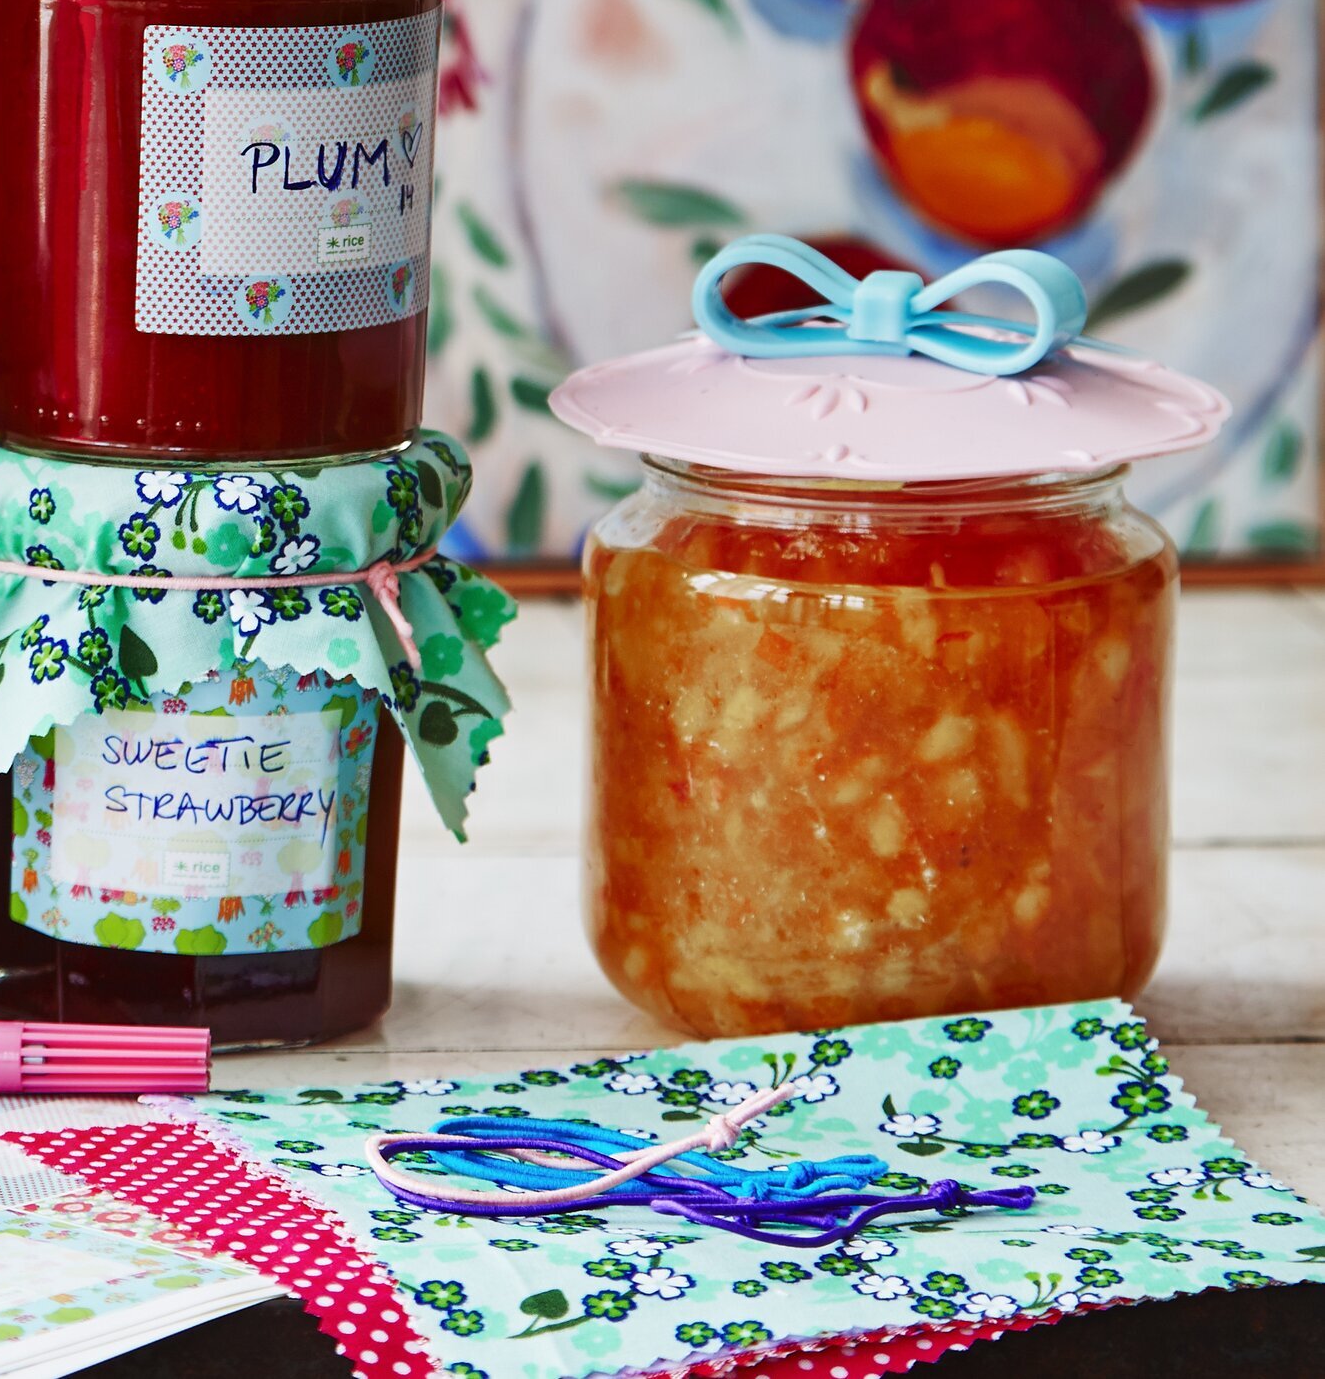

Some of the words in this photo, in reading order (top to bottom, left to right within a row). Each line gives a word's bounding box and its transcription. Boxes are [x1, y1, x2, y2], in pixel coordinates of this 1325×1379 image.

[241, 139, 390, 193] PLUM
[342, 234, 365, 248] rice
[102, 735, 292, 774] SWEETIE
[105, 785, 336, 848] STRAWBERRY
[193, 861, 221, 874] rice
